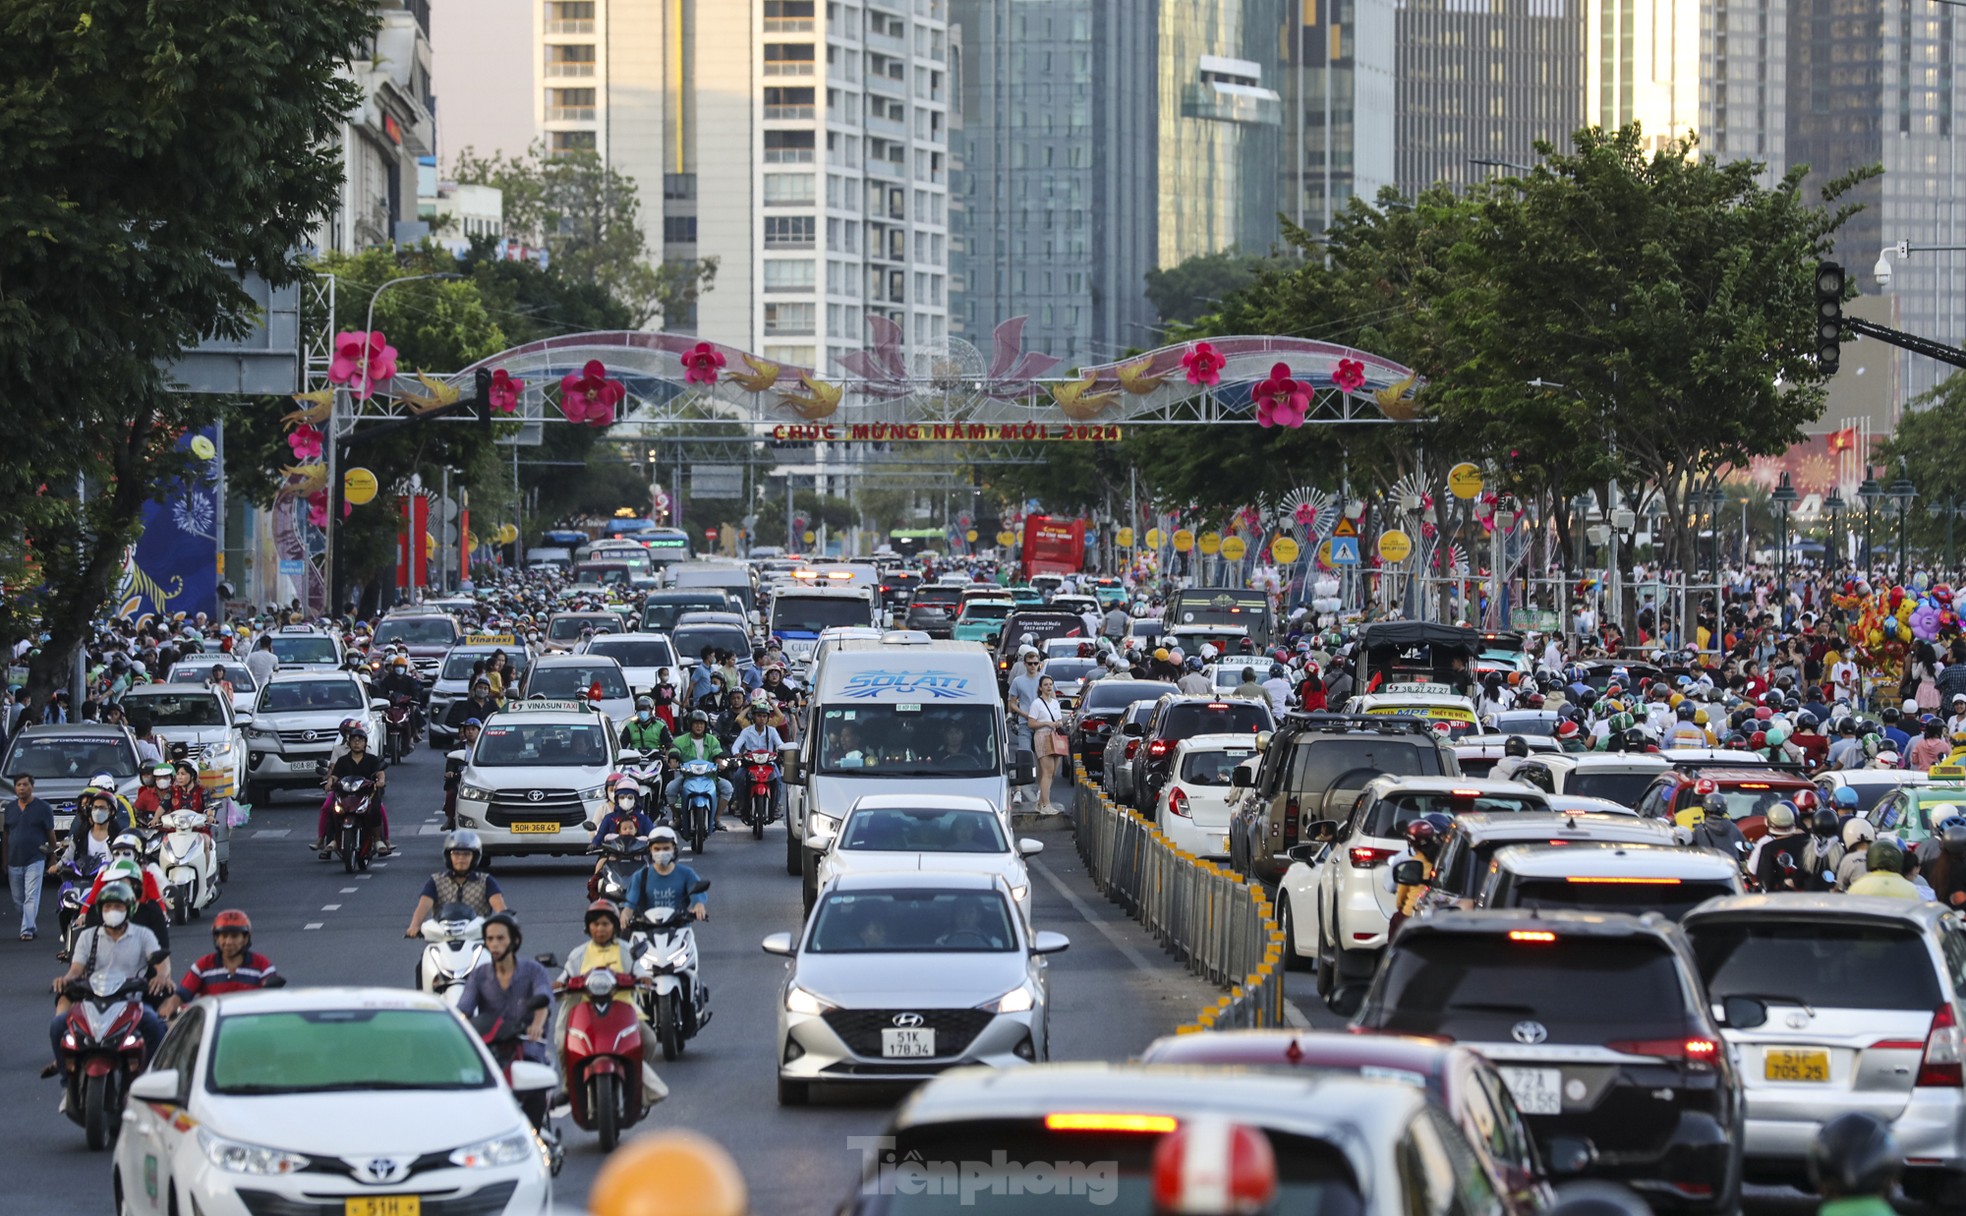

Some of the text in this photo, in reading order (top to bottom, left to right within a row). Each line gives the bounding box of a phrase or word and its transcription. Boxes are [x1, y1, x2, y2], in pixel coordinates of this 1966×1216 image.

[772, 420, 1119, 440] CHÚC MỪNG NĂM MỚI 2024
[469, 635, 512, 644] Vinataxi
[844, 675, 969, 689] SOLATI
[1396, 708, 1430, 717] MPE
[897, 1031, 919, 1043] 51K
[890, 1043, 929, 1056] 178.34
